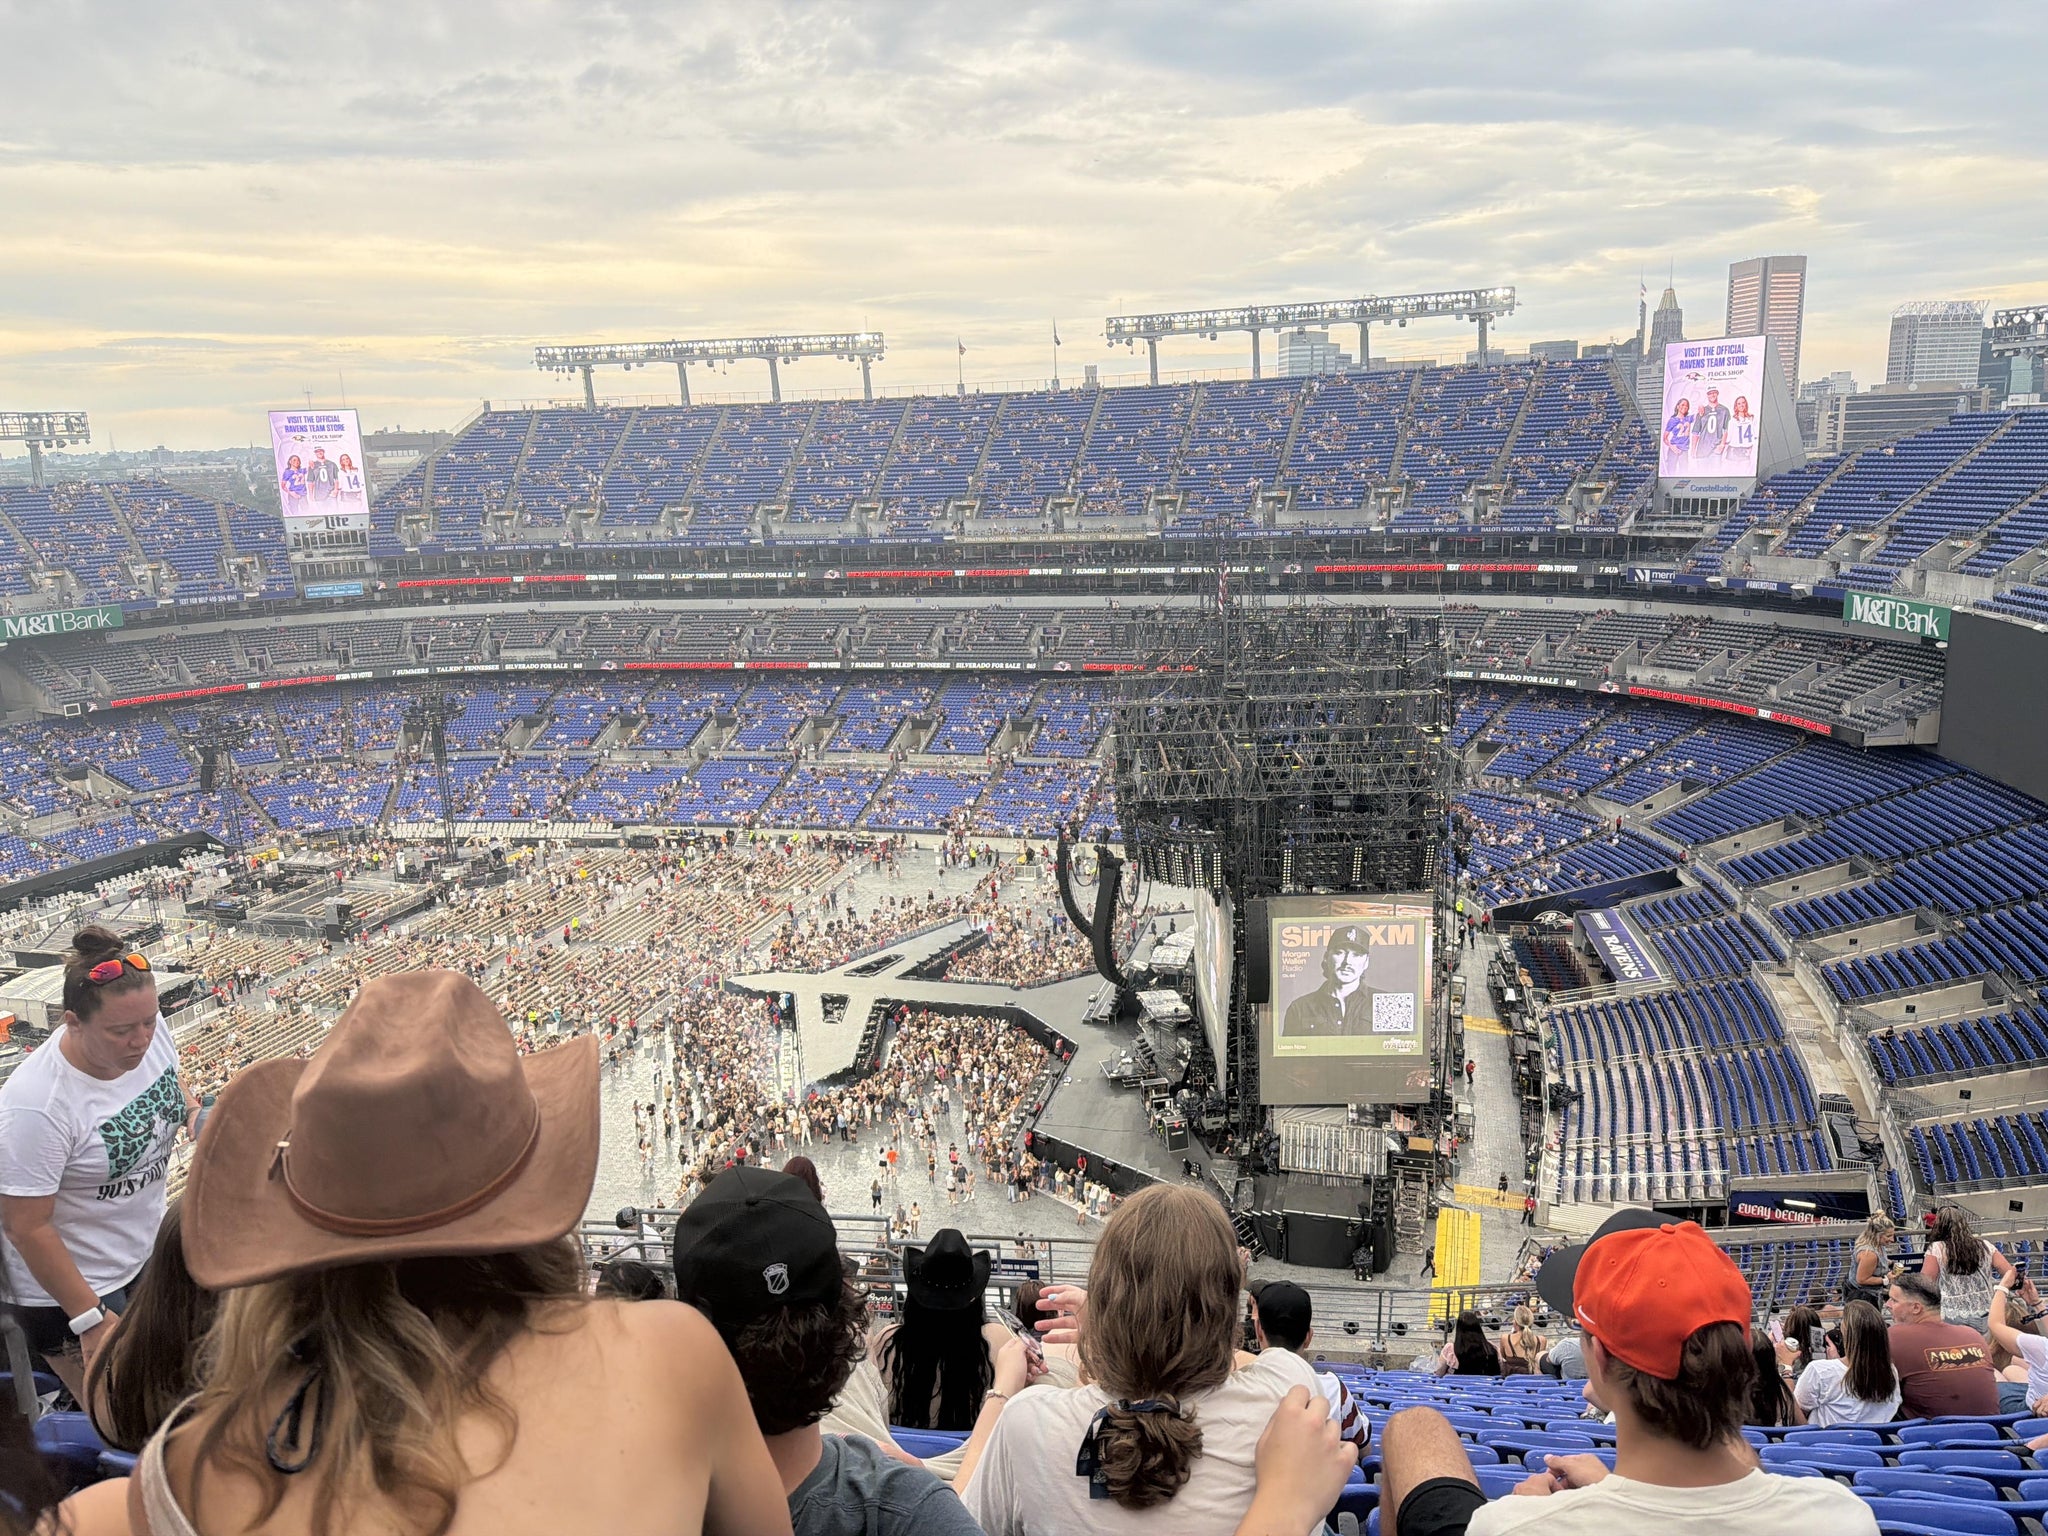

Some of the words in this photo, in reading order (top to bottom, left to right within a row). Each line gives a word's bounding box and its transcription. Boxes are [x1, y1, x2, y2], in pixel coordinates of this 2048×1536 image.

[1684, 346, 1701, 358] VISIT
[1703, 346, 1715, 356] THE
[1716, 343, 1745, 356] OFFICIAL
[1679, 358, 1705, 370] RAVENS
[1707, 357, 1725, 368] TEAM
[1727, 355, 1749, 366] STORE
[286, 415, 302, 424] VISIT
[303, 415, 314, 424] THE
[315, 414, 341, 423] OFFICIAL
[284, 424, 308, 433] RAVENS
[309, 424, 326, 432] TEAM
[326, 423, 345, 432] STORE
[1738, 424, 1753, 444] 14
[1690, 484, 1738, 493] Constellation
[325, 516, 350, 530] Lite
[1460, 563, 1471, 571] ONE
[1471, 563, 1479, 571] OF
[1651, 570, 1676, 580] merri
[1851, 594, 1896, 627] M&T
[1895, 602, 1940, 637] Bank
[5, 613, 59, 638] M&T
[61, 608, 113, 632] Bank
[396, 668, 429, 676] SUMMERS
[436, 665, 464, 673] TALKIN'
[464, 664, 500, 672] TENNESSEE
[1479, 672, 1521, 681] SILVERADO
[1522, 675, 1538, 683] FOR
[1538, 676, 1559, 685] SALE
[1565, 679, 1577, 687] 865
[110, 699, 130, 708] WHICH
[1628, 686, 1648, 695] WHICH
[1648, 688, 1663, 697] SONG
[1663, 691, 1671, 699] DO
[1671, 692, 1683, 701] YOU
[1683, 694, 1699, 704] WANT
[1699, 697, 1707, 705] TO
[1707, 698, 1722, 707] HEAR
[1722, 701, 1733, 710] LIVE
[1758, 708, 1772, 719] TEXT
[1771, 712, 1782, 721] ONE
[1782, 713, 1791, 722] OF
[1804, 720, 1817, 730] SONG
[1282, 950, 1311, 959] Morgan
[1602, 934, 1643, 978] RAVENS
[96, 1178, 138, 1201] 90'S
[1738, 1203, 1771, 1220] EVERY
[1775, 1208, 1816, 1224] DECIBEL
[1930, 1349, 1964, 1362] Aftco
